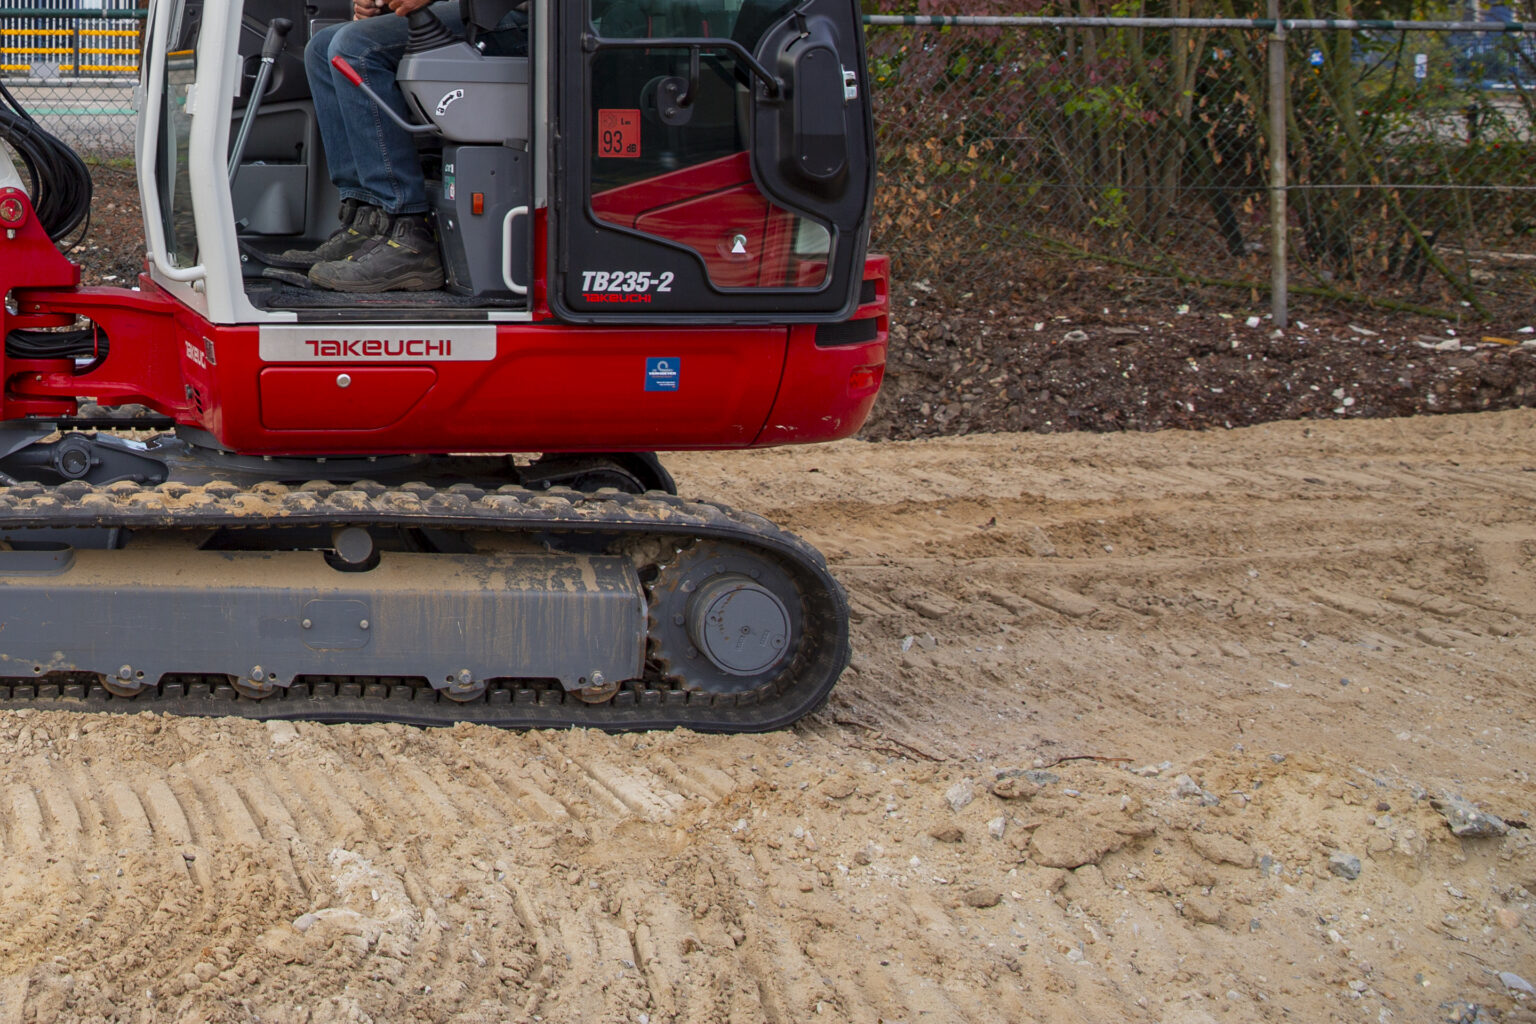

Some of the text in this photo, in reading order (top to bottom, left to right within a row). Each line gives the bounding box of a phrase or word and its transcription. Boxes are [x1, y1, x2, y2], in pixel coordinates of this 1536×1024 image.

[603, 130, 623, 153] 93
[626, 143, 637, 153] dB
[582, 271, 675, 292] TB235-2
[582, 293, 652, 303] TAKEUCHI
[305, 339, 452, 357] TAKEUCHI
